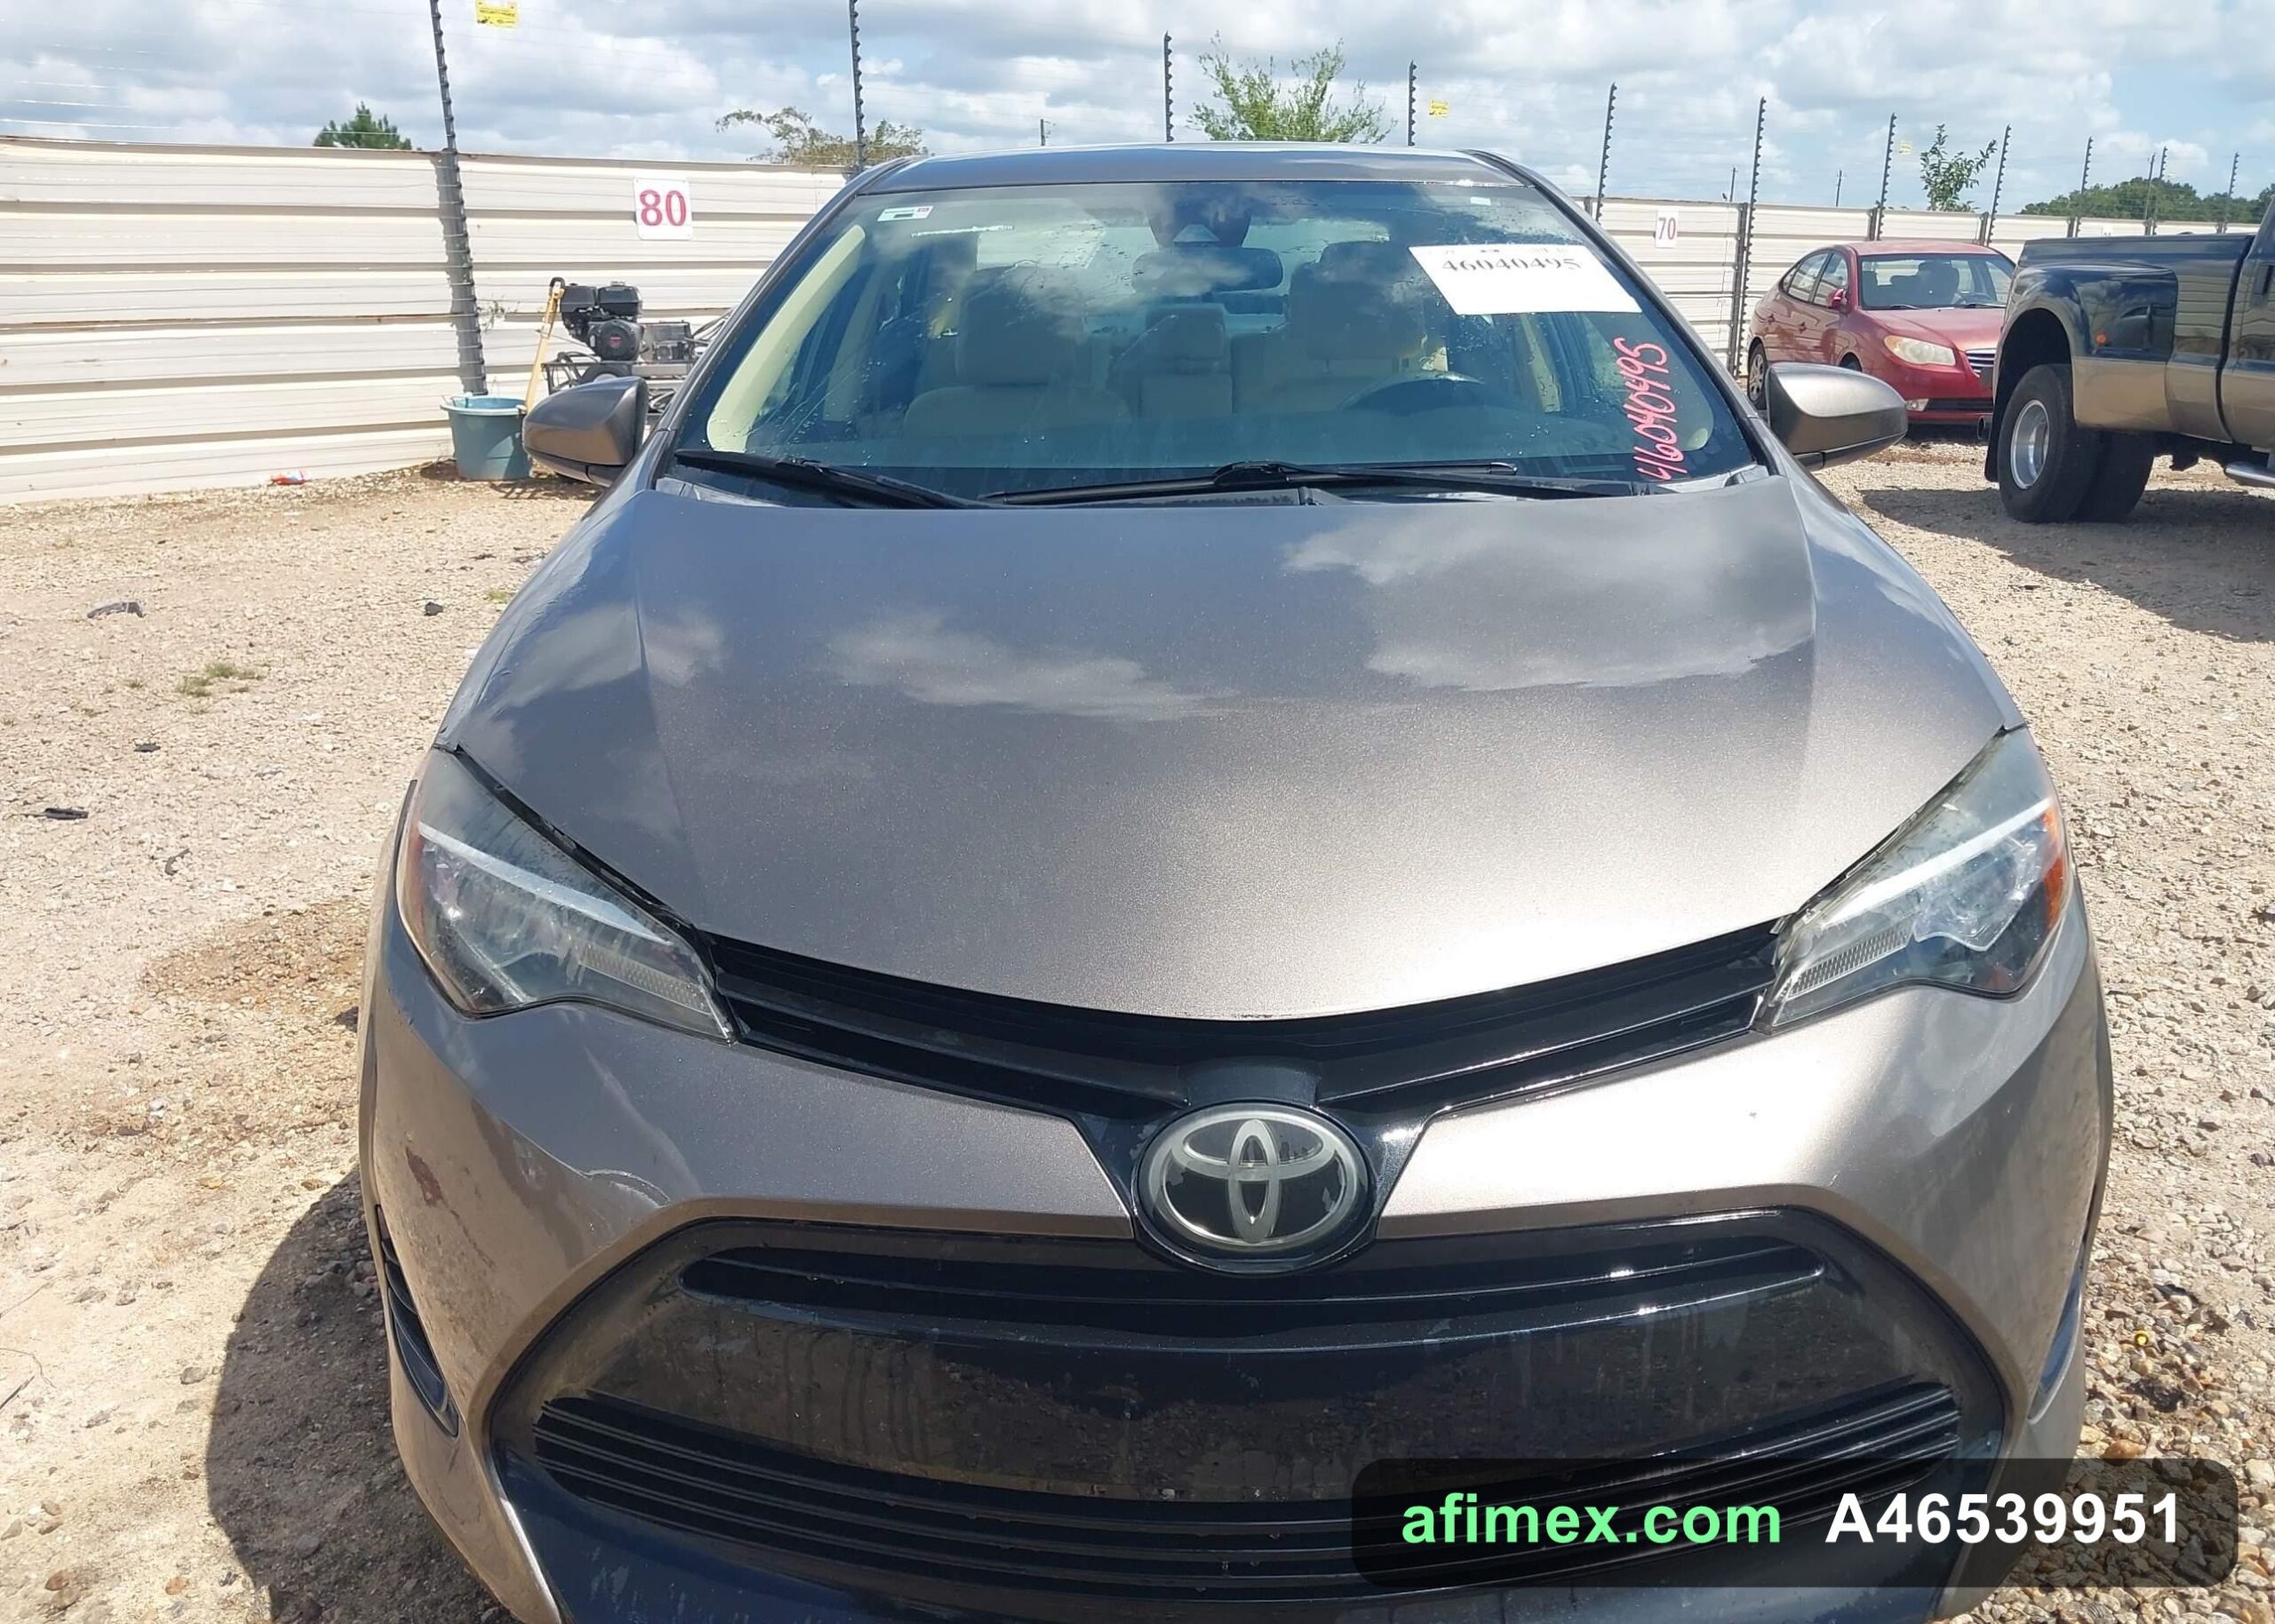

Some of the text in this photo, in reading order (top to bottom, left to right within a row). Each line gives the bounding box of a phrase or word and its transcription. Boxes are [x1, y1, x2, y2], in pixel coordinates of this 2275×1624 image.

[639, 189, 687, 227] 80
[1658, 217, 1676, 240] 70
[1441, 258, 1582, 271] 46040495
[1614, 338, 1688, 481] 46040495
